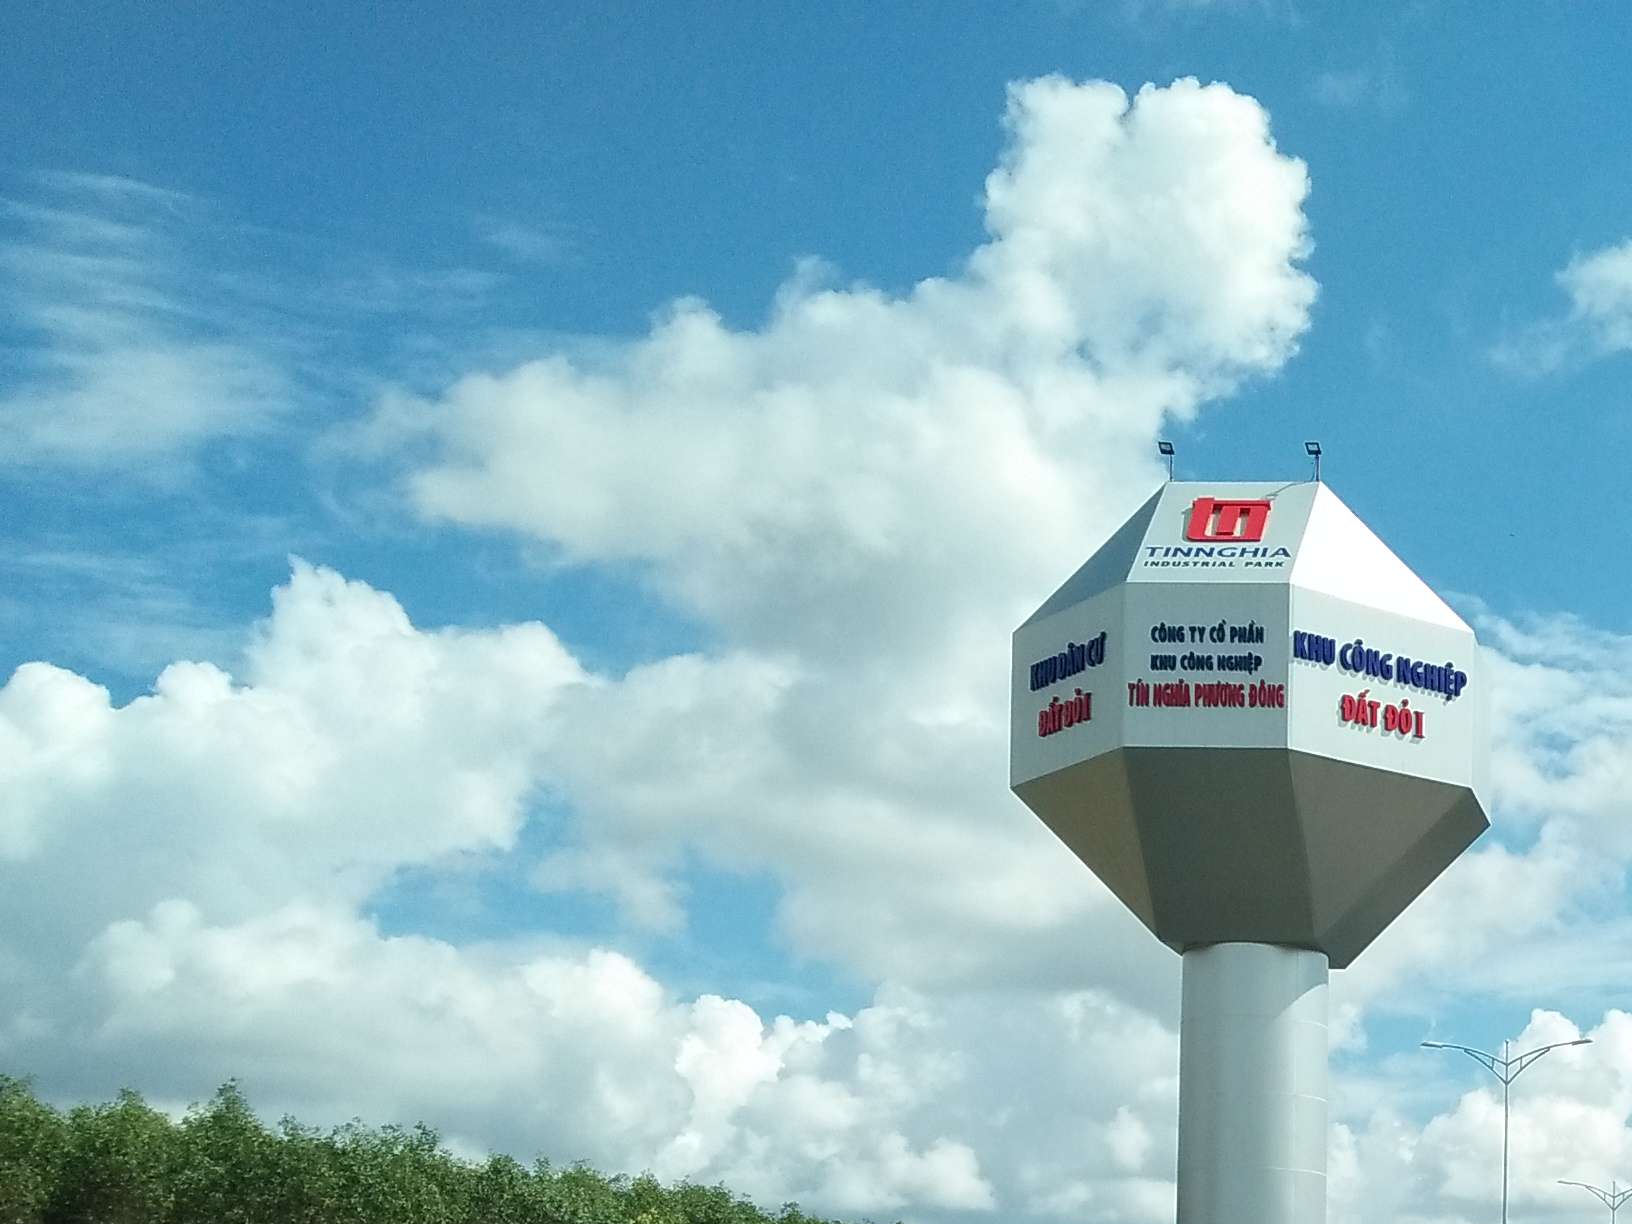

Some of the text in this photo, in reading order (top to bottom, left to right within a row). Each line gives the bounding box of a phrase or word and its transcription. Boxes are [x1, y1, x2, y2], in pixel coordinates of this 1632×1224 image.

[1145, 546, 1291, 558] TINNGHIA
[1150, 622, 1185, 643] CÔNG
[1189, 626, 1206, 643] TY
[1229, 620, 1264, 643] PHẦN
[1030, 655, 1057, 691] KHU
[1086, 631, 1107, 667] CƯ
[1150, 651, 1262, 675] KHU CÔNG NGHIỆP
[1293, 630, 1468, 702] KHU CÔNG NGHIỆP
[1127, 678, 1150, 707] TÍN
[1152, 678, 1191, 707] NGHĨA
[1248, 679, 1285, 708] ĐÔNG
[1340, 689, 1381, 728] ĐẤT
[1384, 699, 1412, 735] ĐỎ
